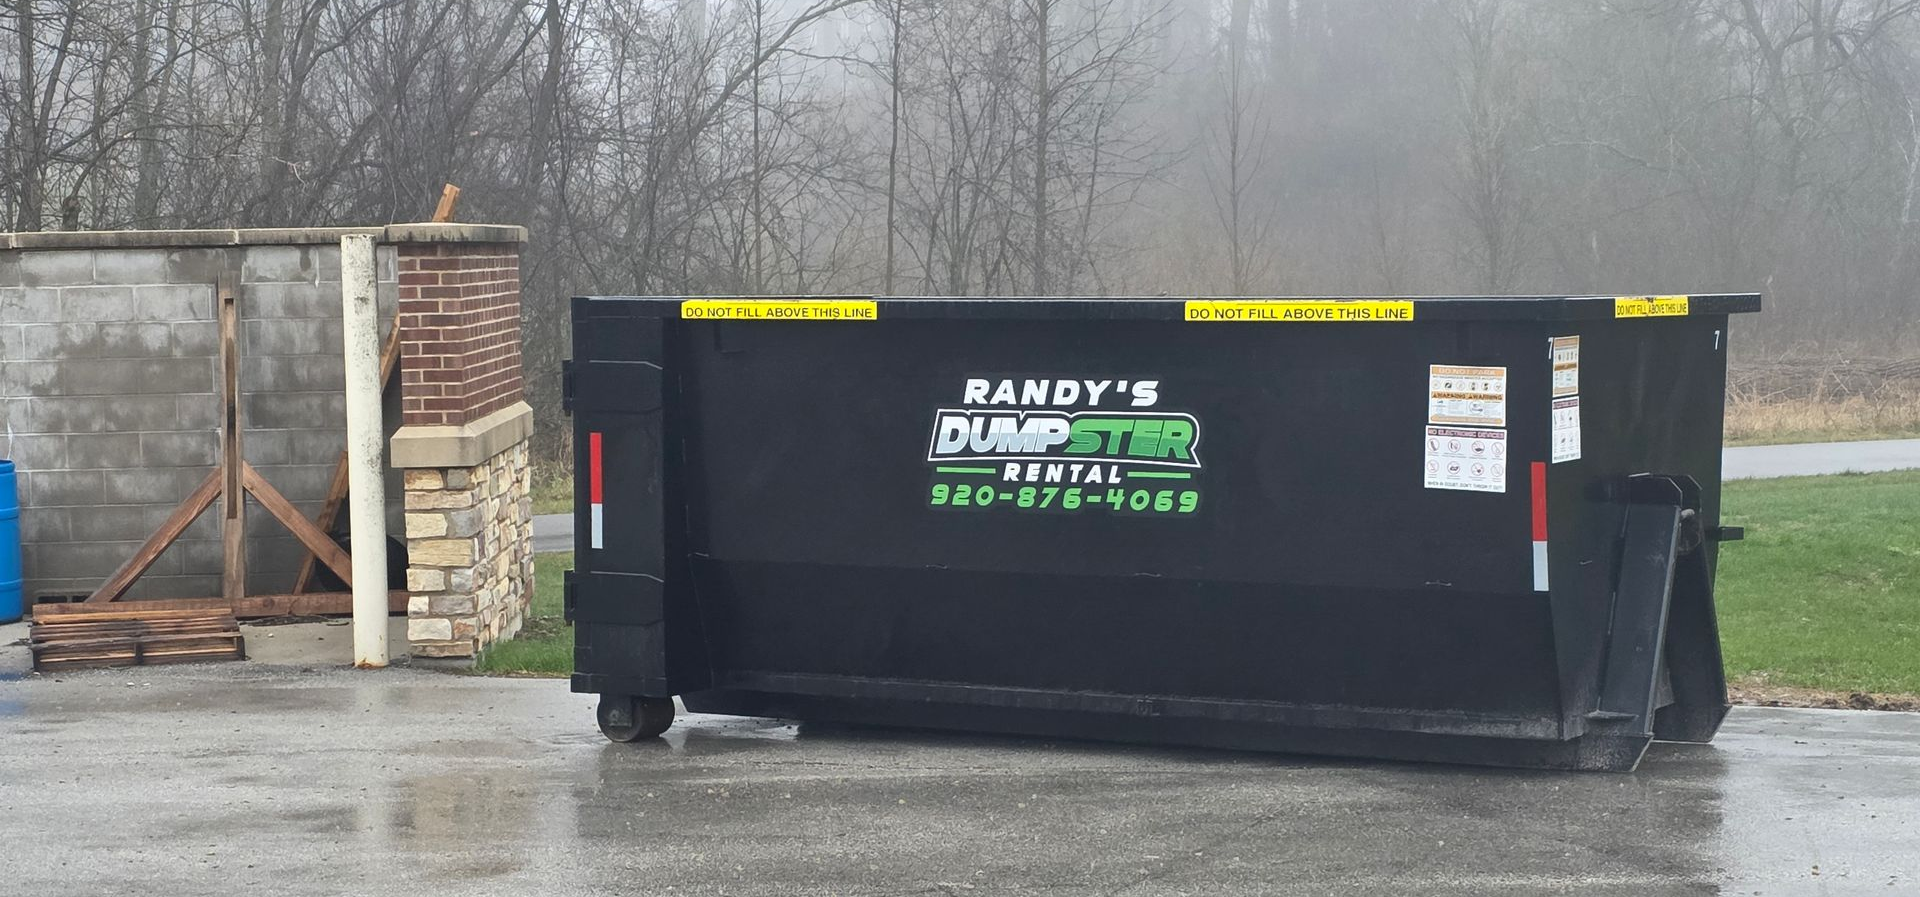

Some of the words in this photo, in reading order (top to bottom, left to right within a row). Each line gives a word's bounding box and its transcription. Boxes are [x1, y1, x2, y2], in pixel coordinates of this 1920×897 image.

[685, 307, 703, 318] DO
[707, 307, 732, 318] NOT
[736, 307, 760, 318] FILL
[766, 307, 809, 318] ABOVE
[813, 307, 841, 318] THIS
[844, 307, 872, 318] LINE
[1190, 308, 1210, 319] DO
[1214, 308, 1243, 319] NOT
[1248, 308, 1278, 319] FILL
[1283, 308, 1334, 319] ABOVE
[1338, 308, 1371, 319] THIS
[1375, 308, 1409, 319] LINE
[1617, 305, 1625, 315] DO
[1626, 305, 1636, 315] NOT
[1637, 304, 1647, 314] FILL
[1665, 303, 1676, 314] THIS
[1676, 303, 1687, 313] LINE
[1714, 330, 1720, 350] 7
[963, 378, 1159, 407] RANDY'S
[935, 415, 1194, 460] DUMPSTER
[1003, 462, 1122, 484] RENTAL
[930, 483, 1199, 513] 920-876-4069
